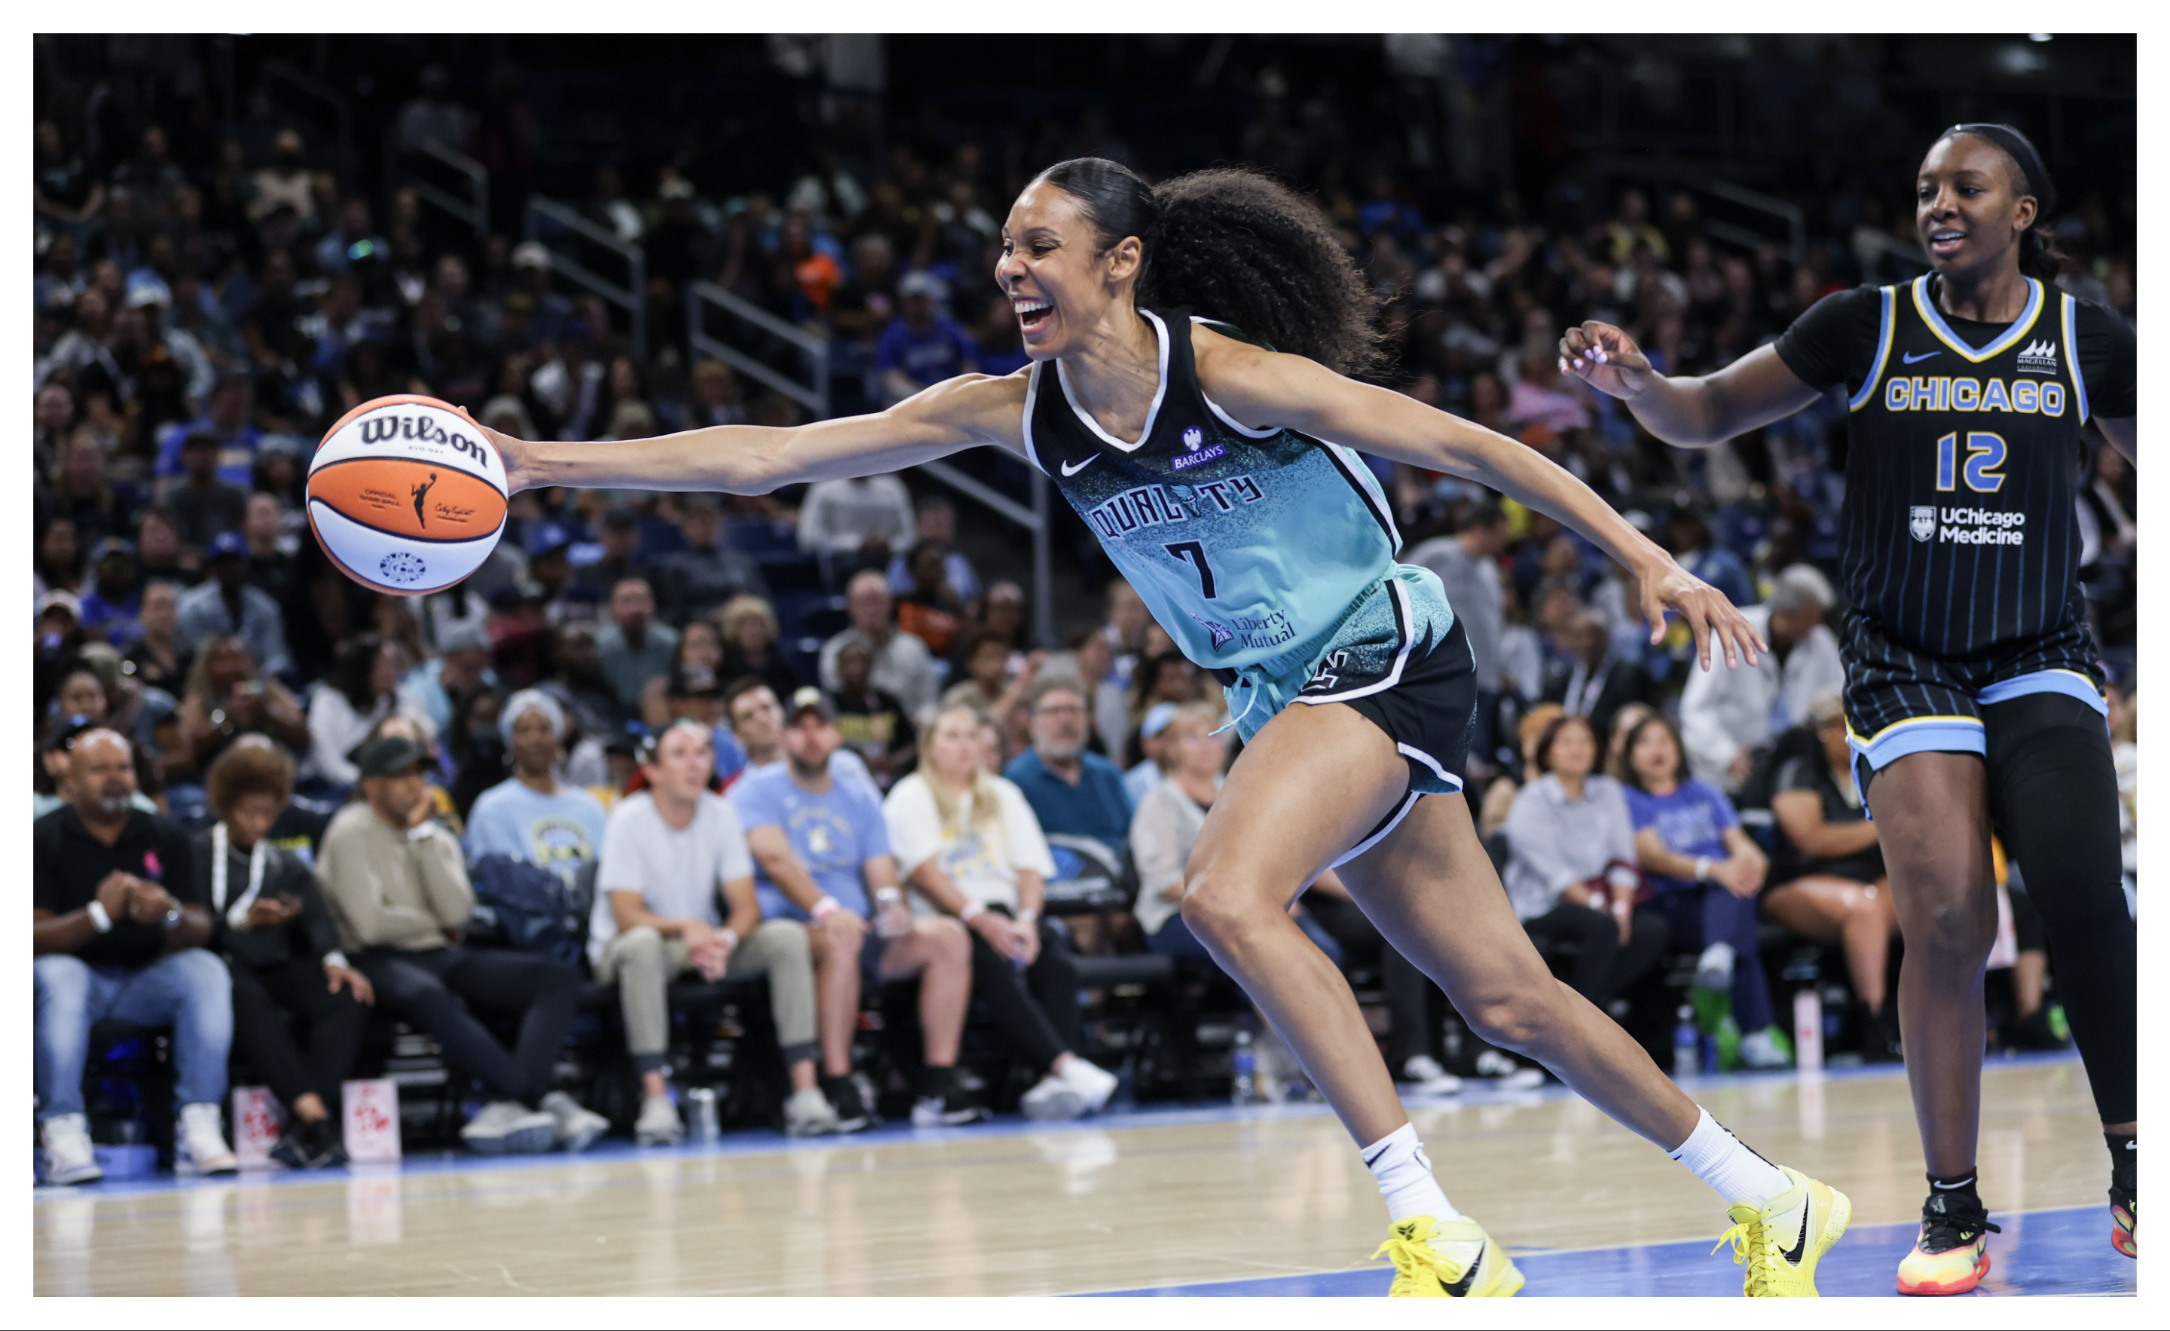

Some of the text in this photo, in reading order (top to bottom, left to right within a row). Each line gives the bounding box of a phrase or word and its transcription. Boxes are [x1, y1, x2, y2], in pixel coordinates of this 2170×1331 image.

[2017, 357, 2057, 367] MAGELLAN
[1886, 376, 2065, 417] CHICAGO
[359, 415, 487, 468] Wilson
[1174, 445, 1223, 469] BARCLAYS
[1936, 431, 2007, 492] 12
[1941, 508, 2025, 529] UChicago
[1940, 527, 2023, 545] Medicine
[1162, 542, 1218, 600] 7
[1231, 609, 1285, 630] Liberty
[1240, 621, 1297, 649] Mutual
